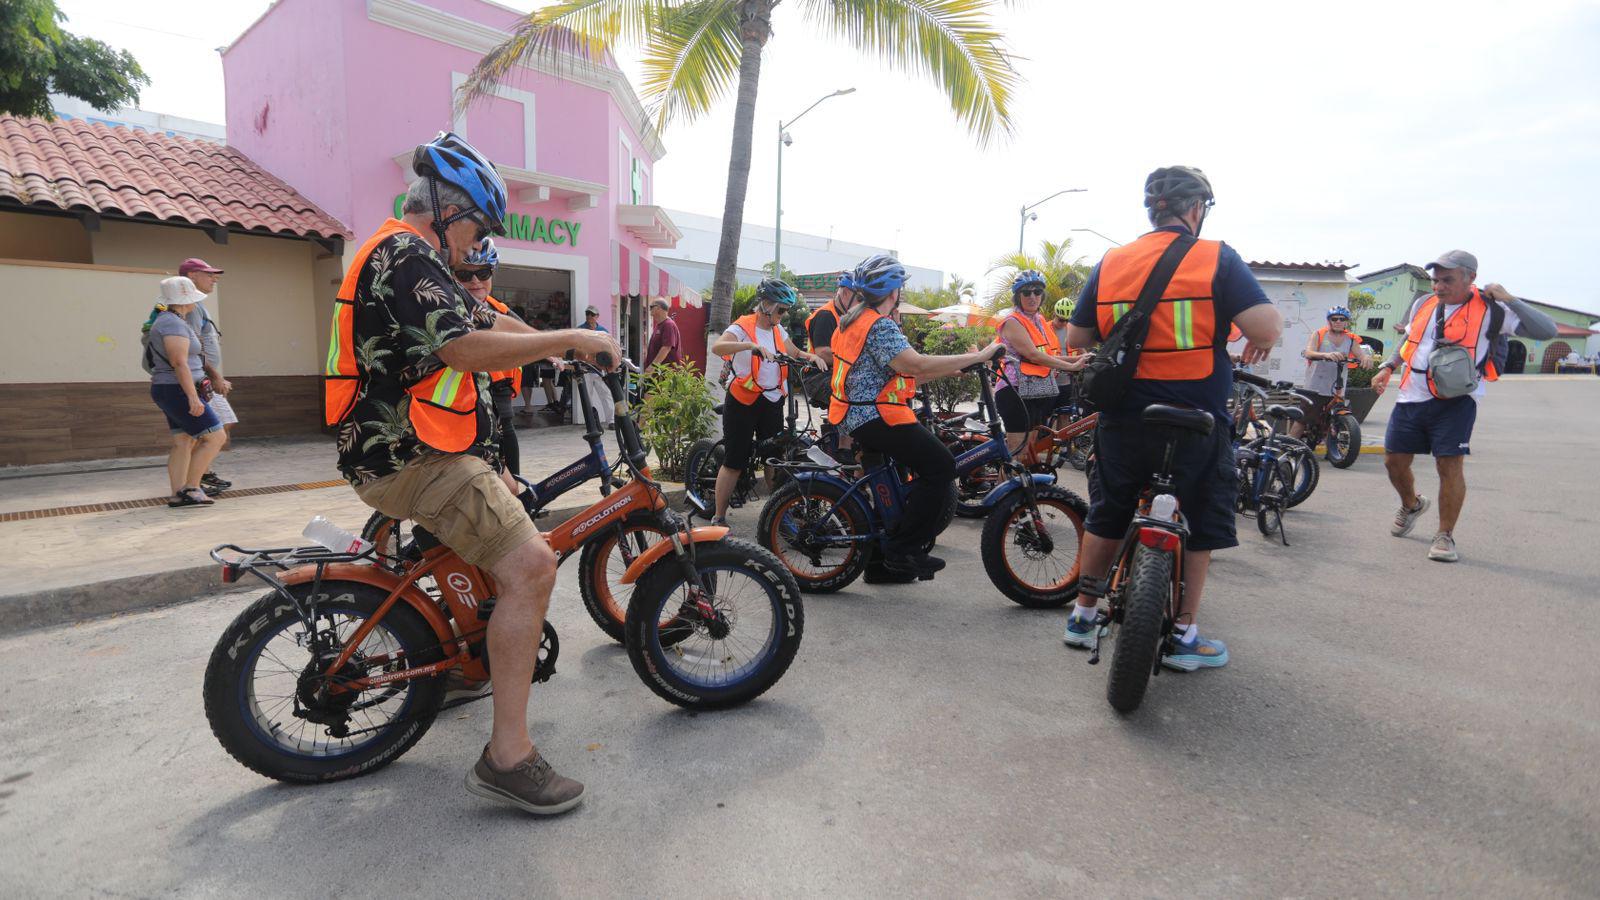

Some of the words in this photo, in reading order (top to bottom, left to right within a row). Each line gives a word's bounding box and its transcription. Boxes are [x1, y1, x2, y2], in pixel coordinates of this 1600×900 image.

[586, 495, 632, 527] CICLOTRON
[744, 559, 796, 637] KENDA
[369, 665, 436, 684] ciclotron.com.mx
